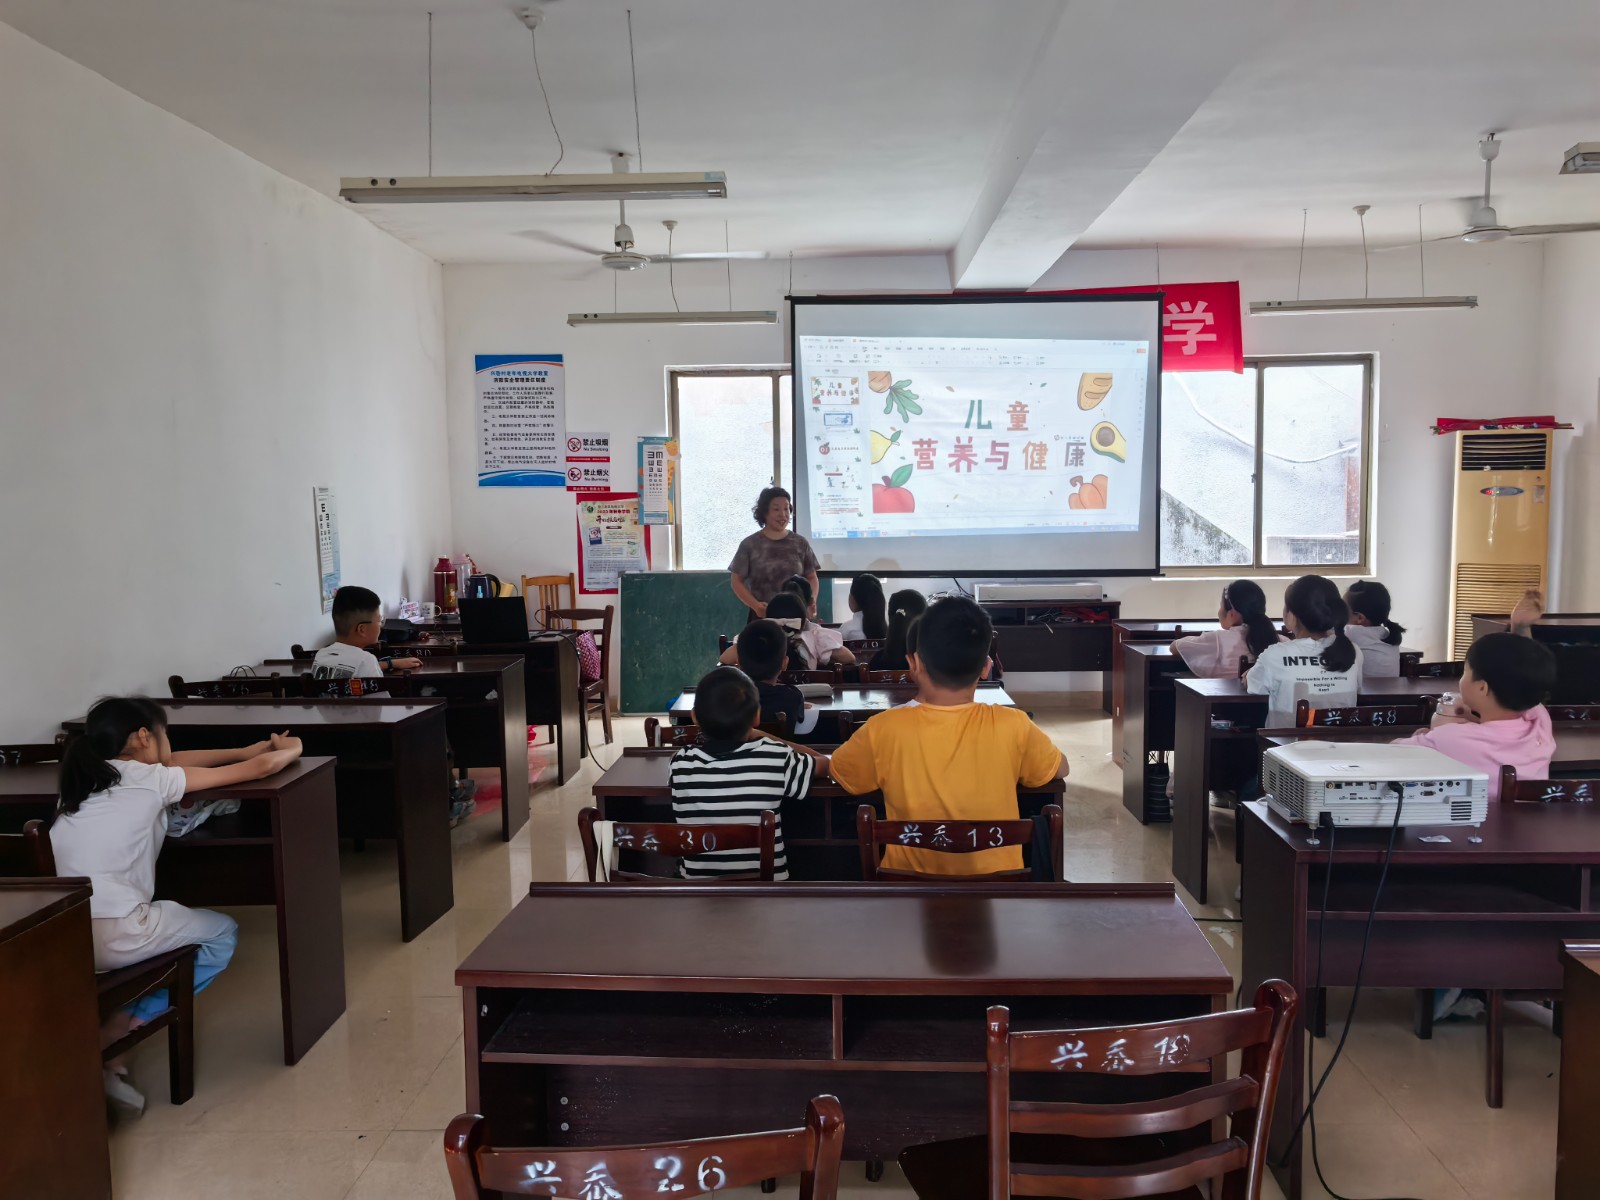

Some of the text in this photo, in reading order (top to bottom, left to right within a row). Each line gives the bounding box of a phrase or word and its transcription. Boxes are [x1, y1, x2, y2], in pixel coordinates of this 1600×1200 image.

[1163, 301, 1217, 355] 学
[964, 399, 1030, 431] 儿童
[583, 438, 609, 446] 禁止吸烟
[912, 436, 1087, 473] 营养与健康
[583, 469, 610, 477] 禁止烟火
[1371, 709, 1397, 727] 58
[680, 830, 716, 851] 30
[967, 827, 1004, 848] 13
[654, 1155, 726, 1193] 26
